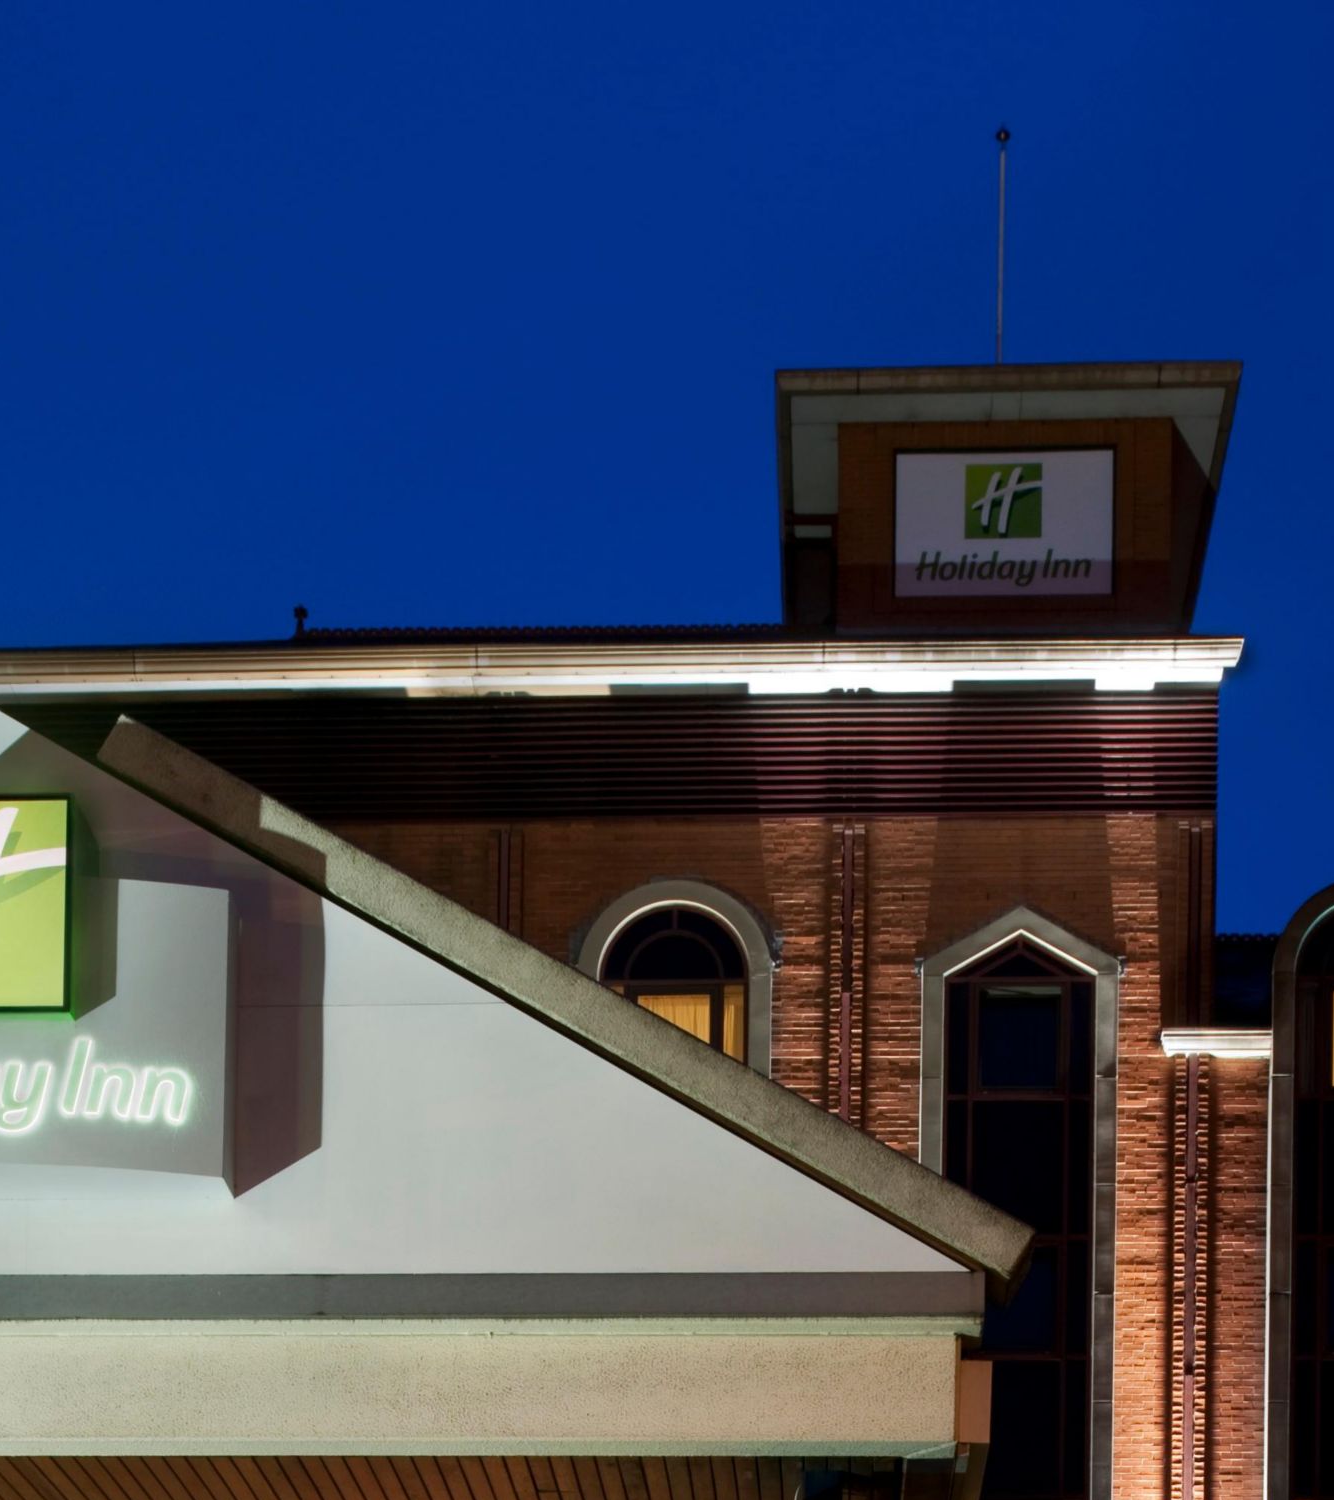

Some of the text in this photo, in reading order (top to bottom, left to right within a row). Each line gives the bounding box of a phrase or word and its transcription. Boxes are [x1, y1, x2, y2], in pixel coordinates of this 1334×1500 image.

[971, 466, 1042, 535] H
[915, 548, 1092, 587] Holiday Inn
[64, 1036, 193, 1126] Inn
